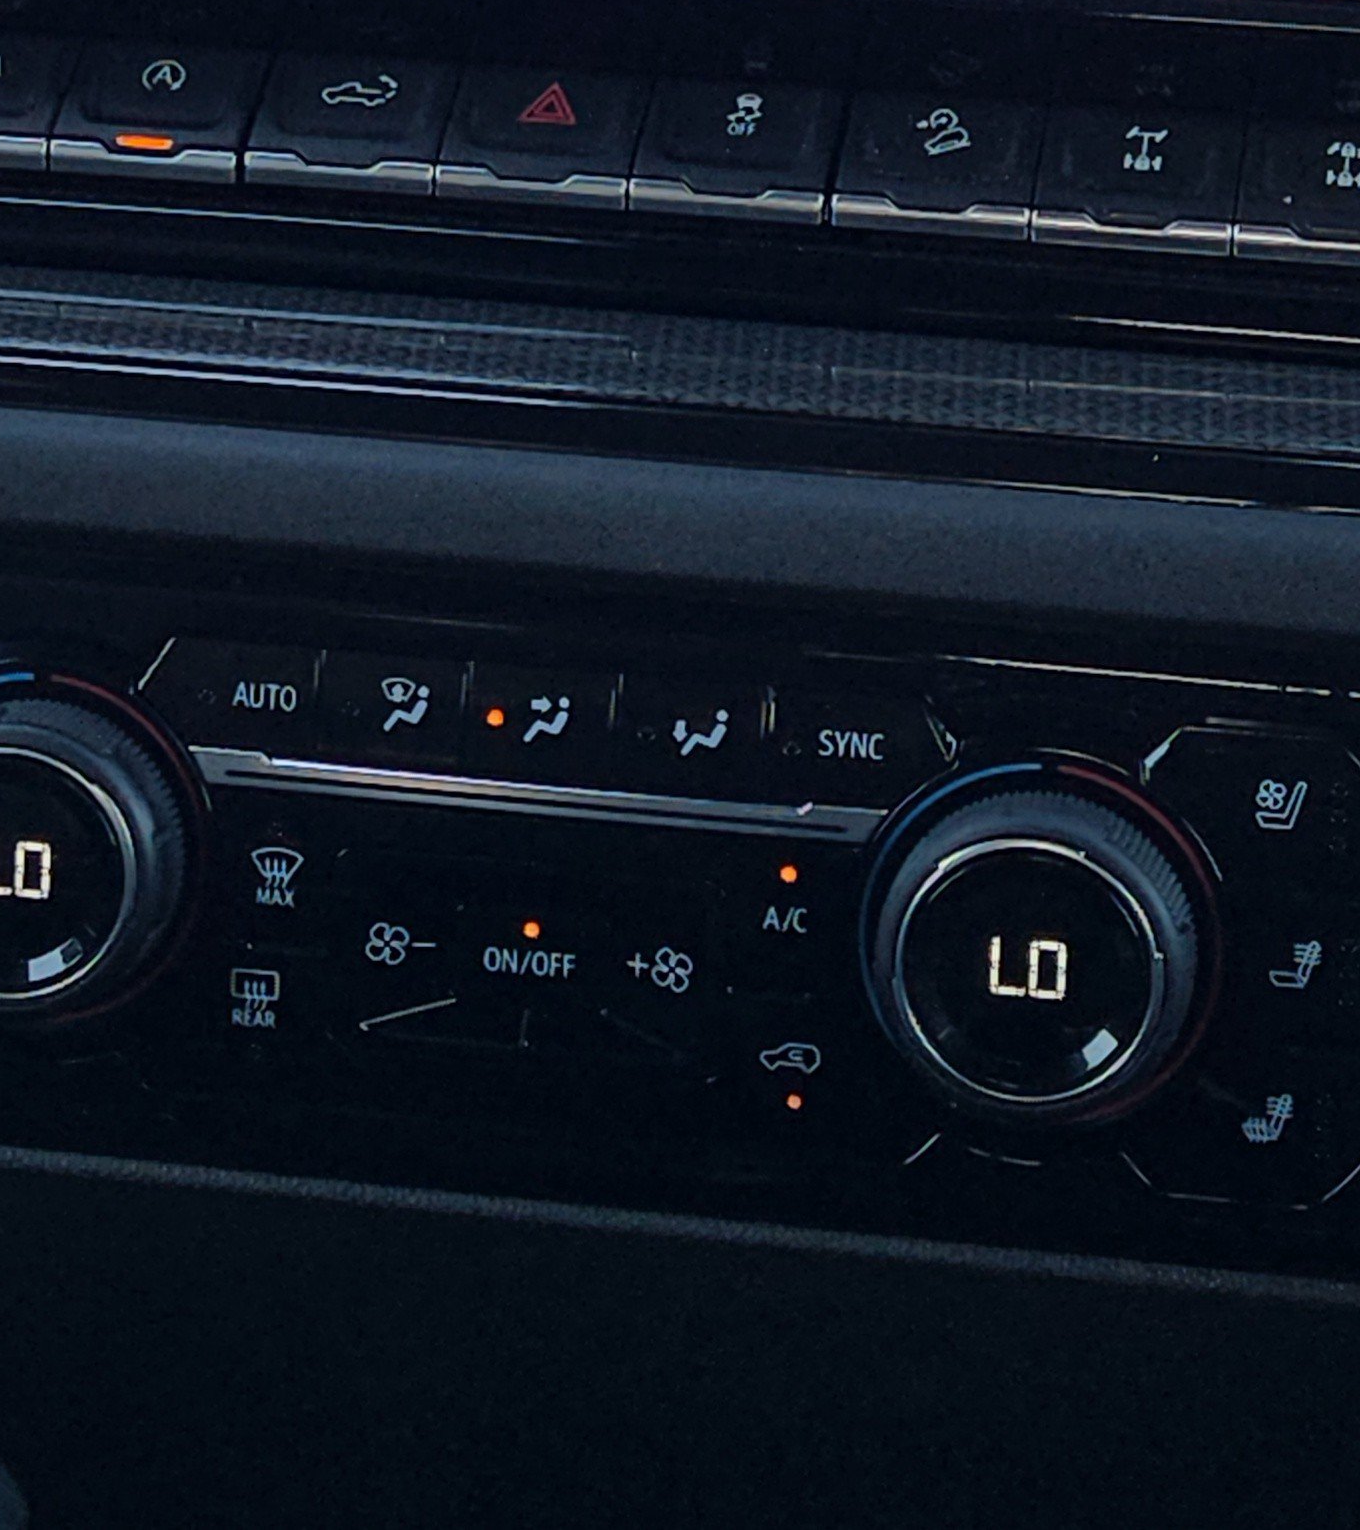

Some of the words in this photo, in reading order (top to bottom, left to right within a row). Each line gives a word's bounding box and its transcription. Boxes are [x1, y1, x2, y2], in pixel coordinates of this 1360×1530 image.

[726, 122, 757, 138] OFF
[232, 681, 297, 712] AUTO
[818, 730, 885, 762] SYNC
[255, 886, 295, 909] MAX
[762, 907, 808, 934] A/C
[483, 946, 576, 978] ON/OFF
[989, 936, 1068, 1001] LO
[231, 1008, 276, 1030] REAR
